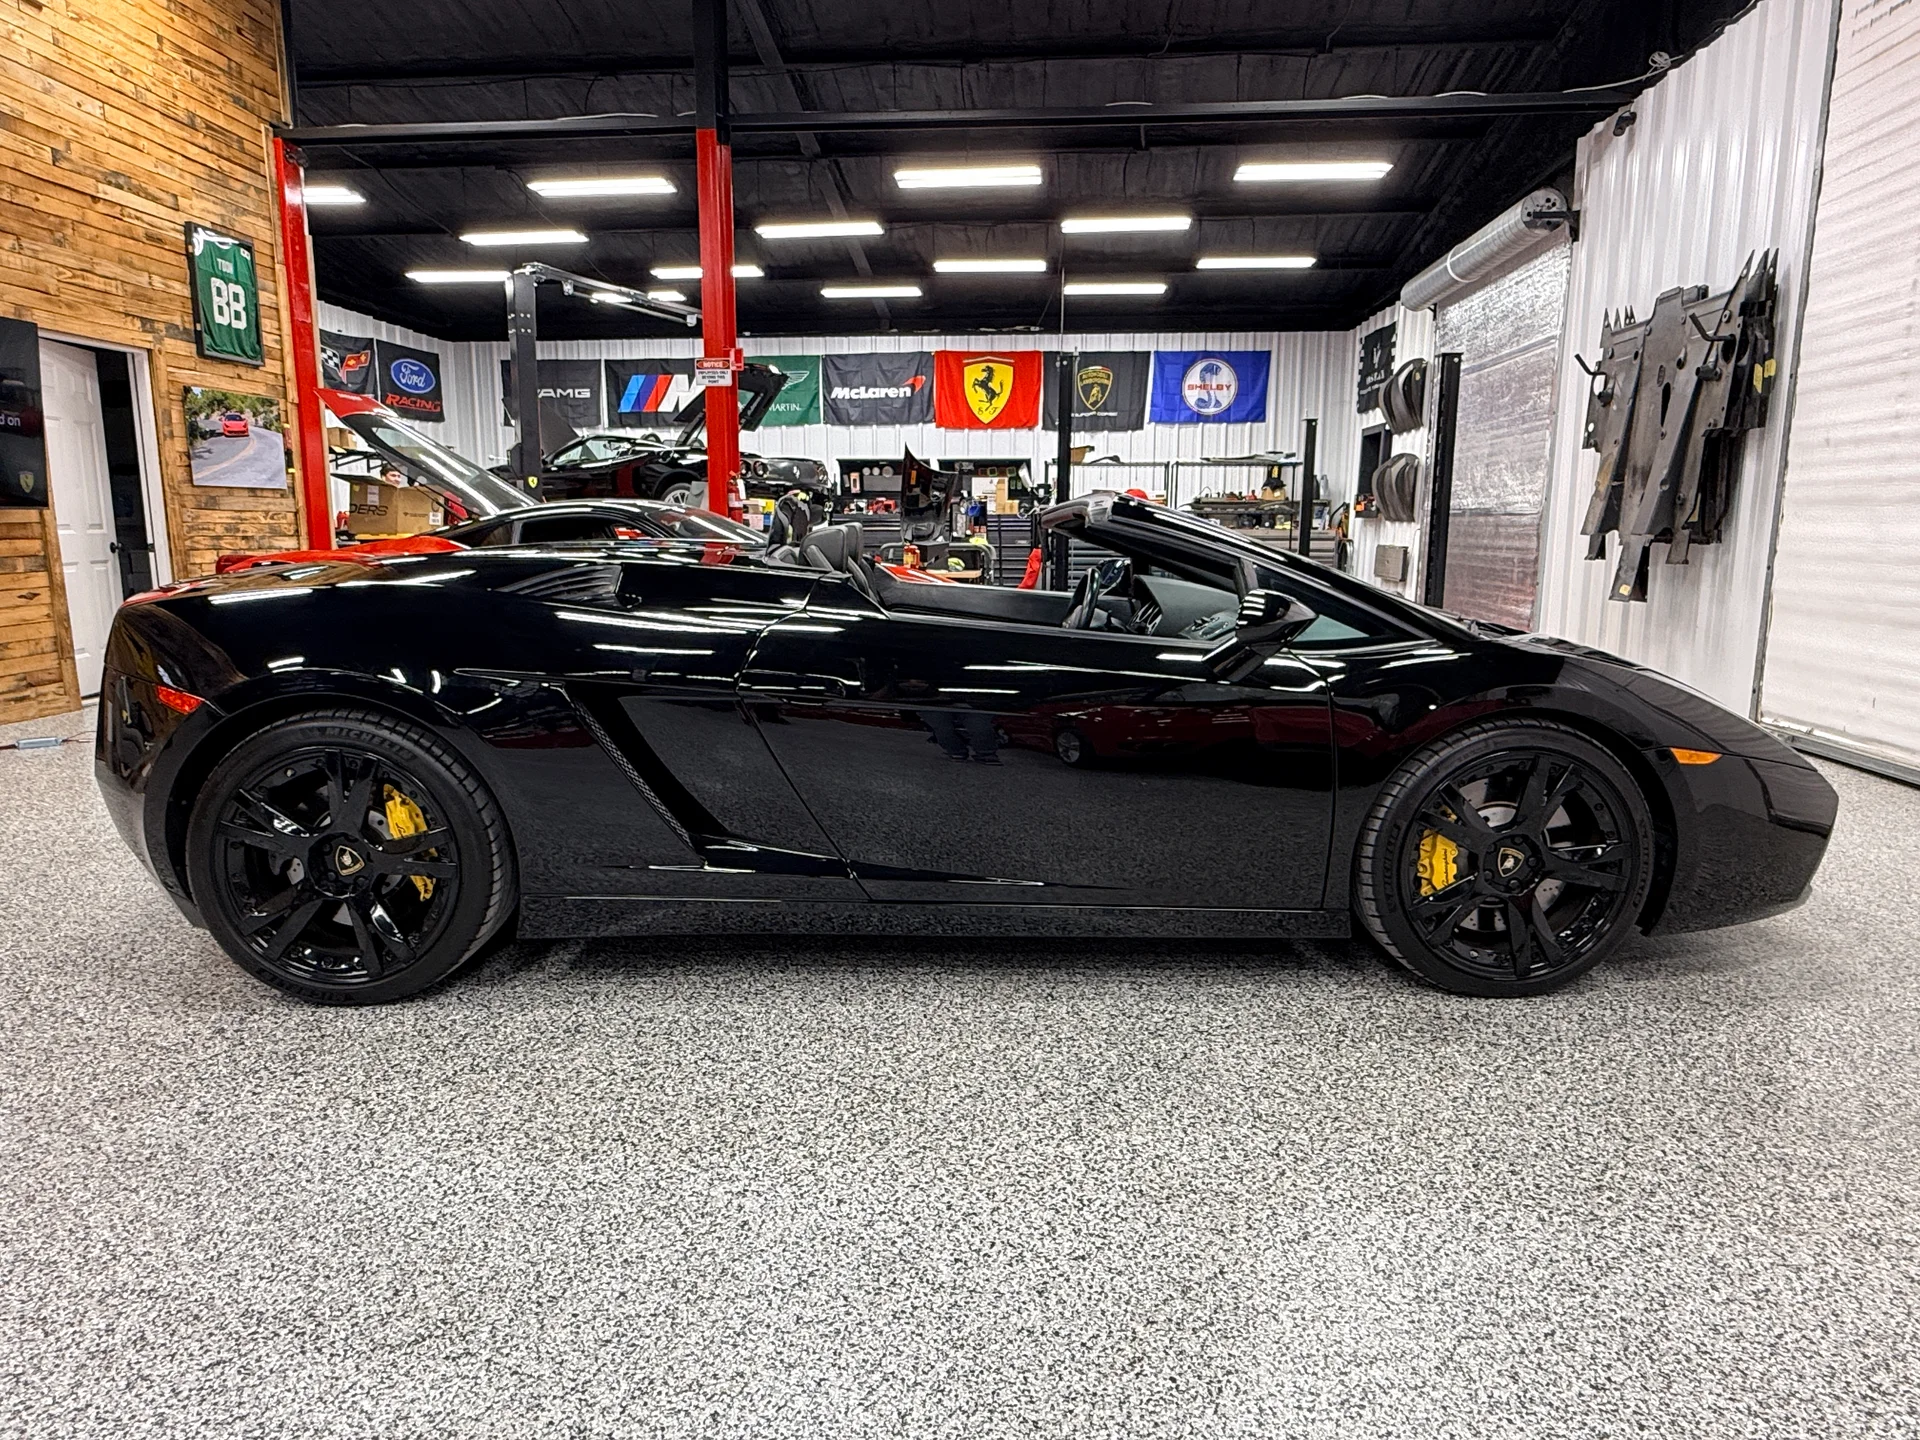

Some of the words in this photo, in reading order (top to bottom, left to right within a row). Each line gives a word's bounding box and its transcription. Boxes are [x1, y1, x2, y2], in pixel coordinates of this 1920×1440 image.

[211, 277, 247, 330] 88
[400, 362, 426, 388] Ford
[538, 388, 590, 399] AMG
[831, 386, 912, 399] McLaren
[386, 393, 440, 412] RACING
[769, 403, 800, 411] MARTIN
[7, 417, 21, 427] on
